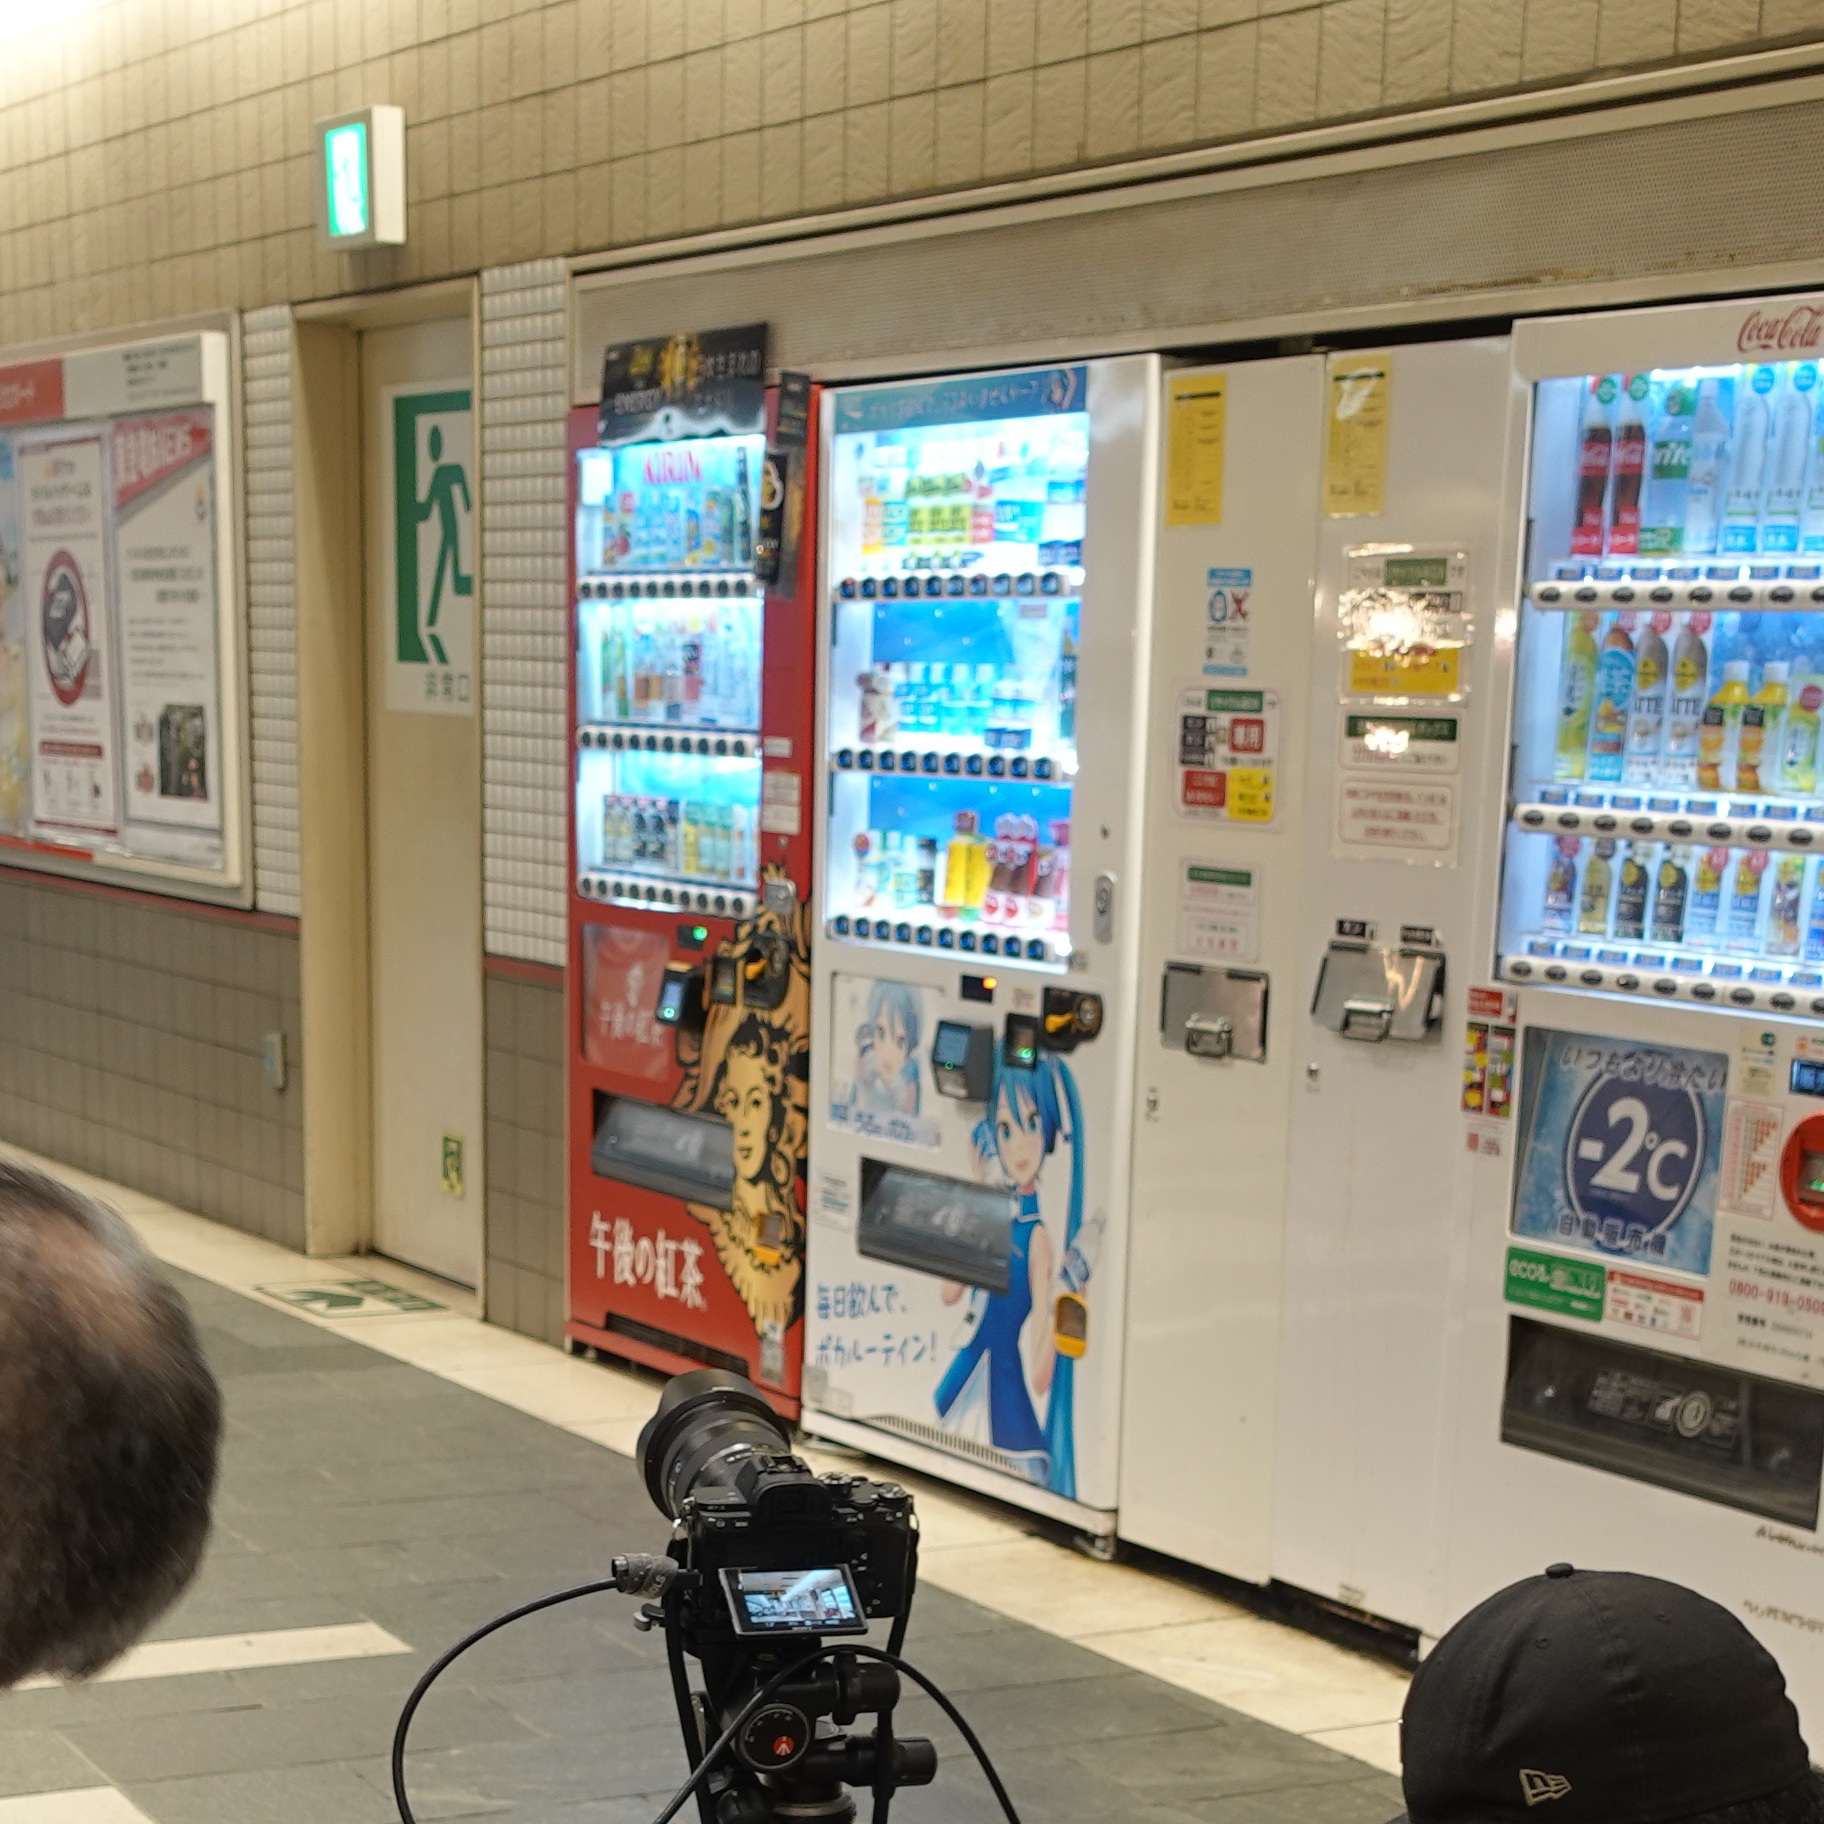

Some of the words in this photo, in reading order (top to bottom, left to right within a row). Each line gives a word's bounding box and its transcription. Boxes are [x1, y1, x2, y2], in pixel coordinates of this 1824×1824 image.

[589, 1210, 708, 1311] 午後の紅茶
